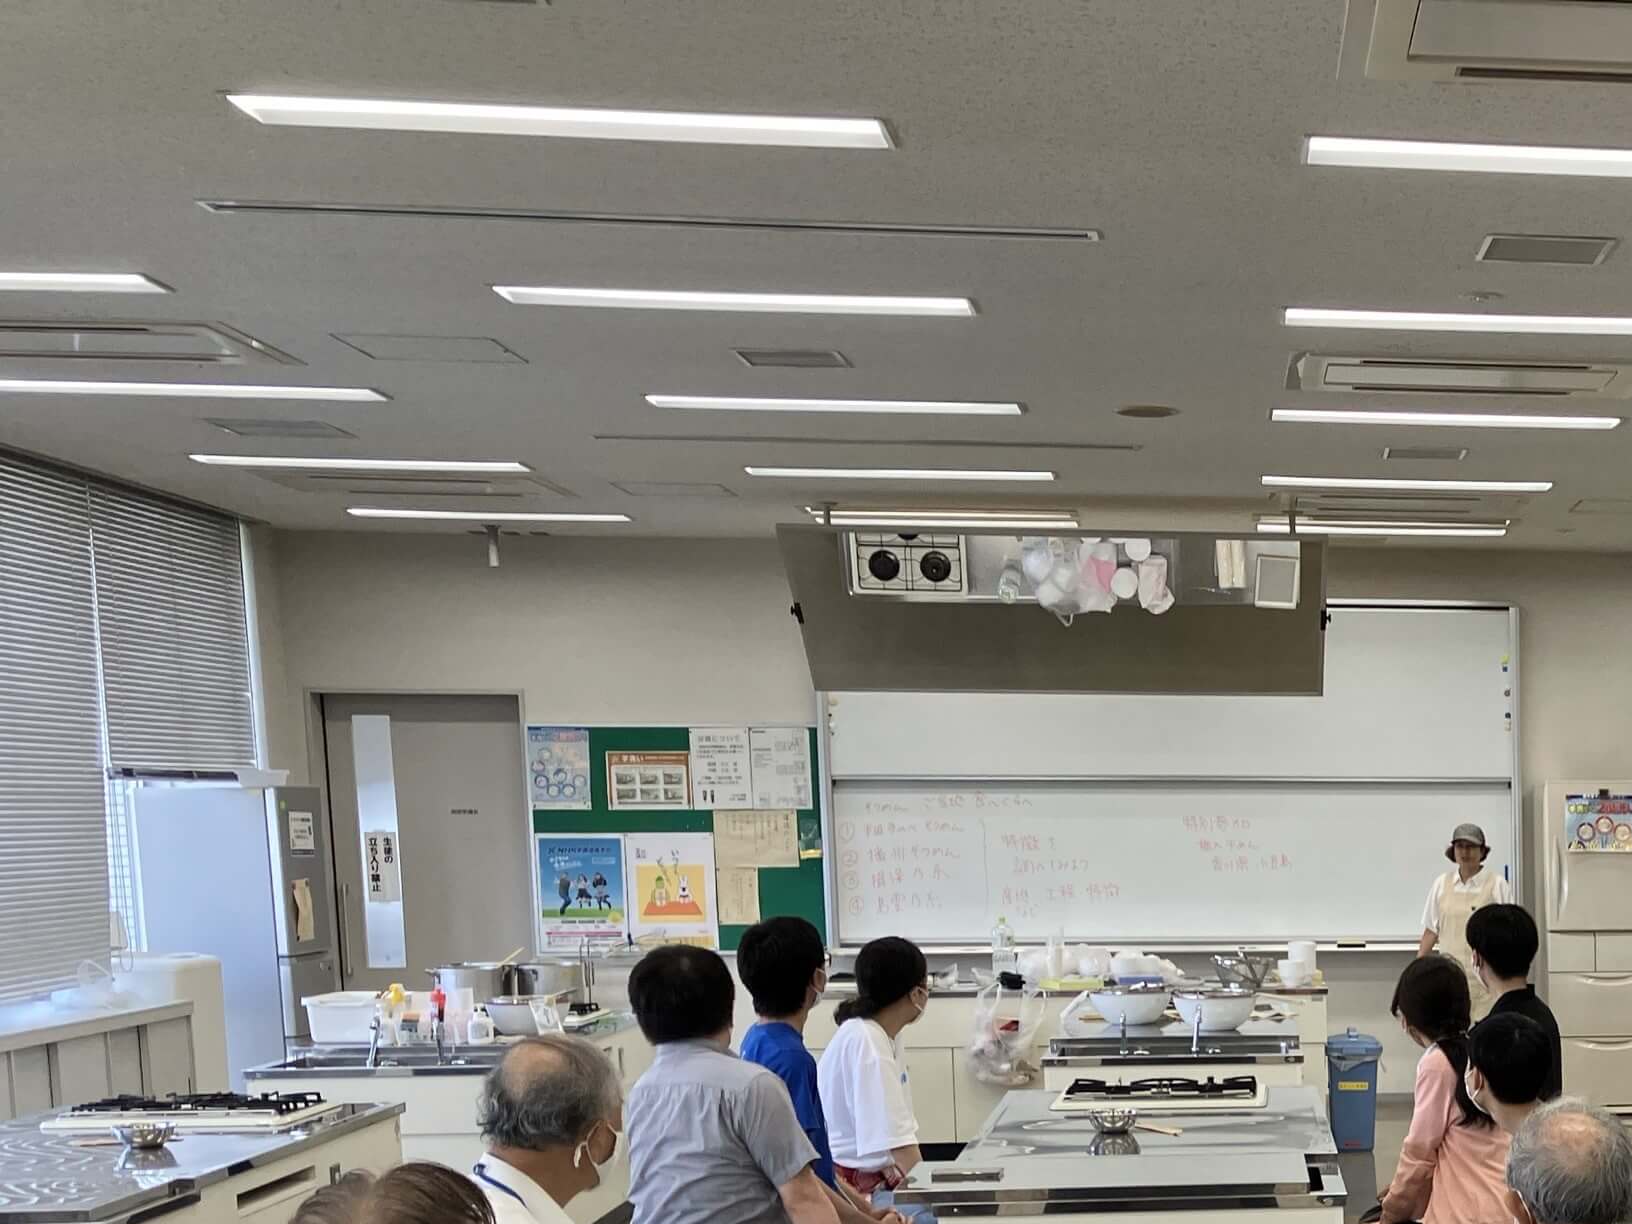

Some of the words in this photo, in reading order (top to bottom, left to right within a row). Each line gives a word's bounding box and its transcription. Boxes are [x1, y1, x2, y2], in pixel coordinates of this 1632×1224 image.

[368, 837, 382, 893] 立ち入り禁止
[383, 837, 394, 864] 生徒の
